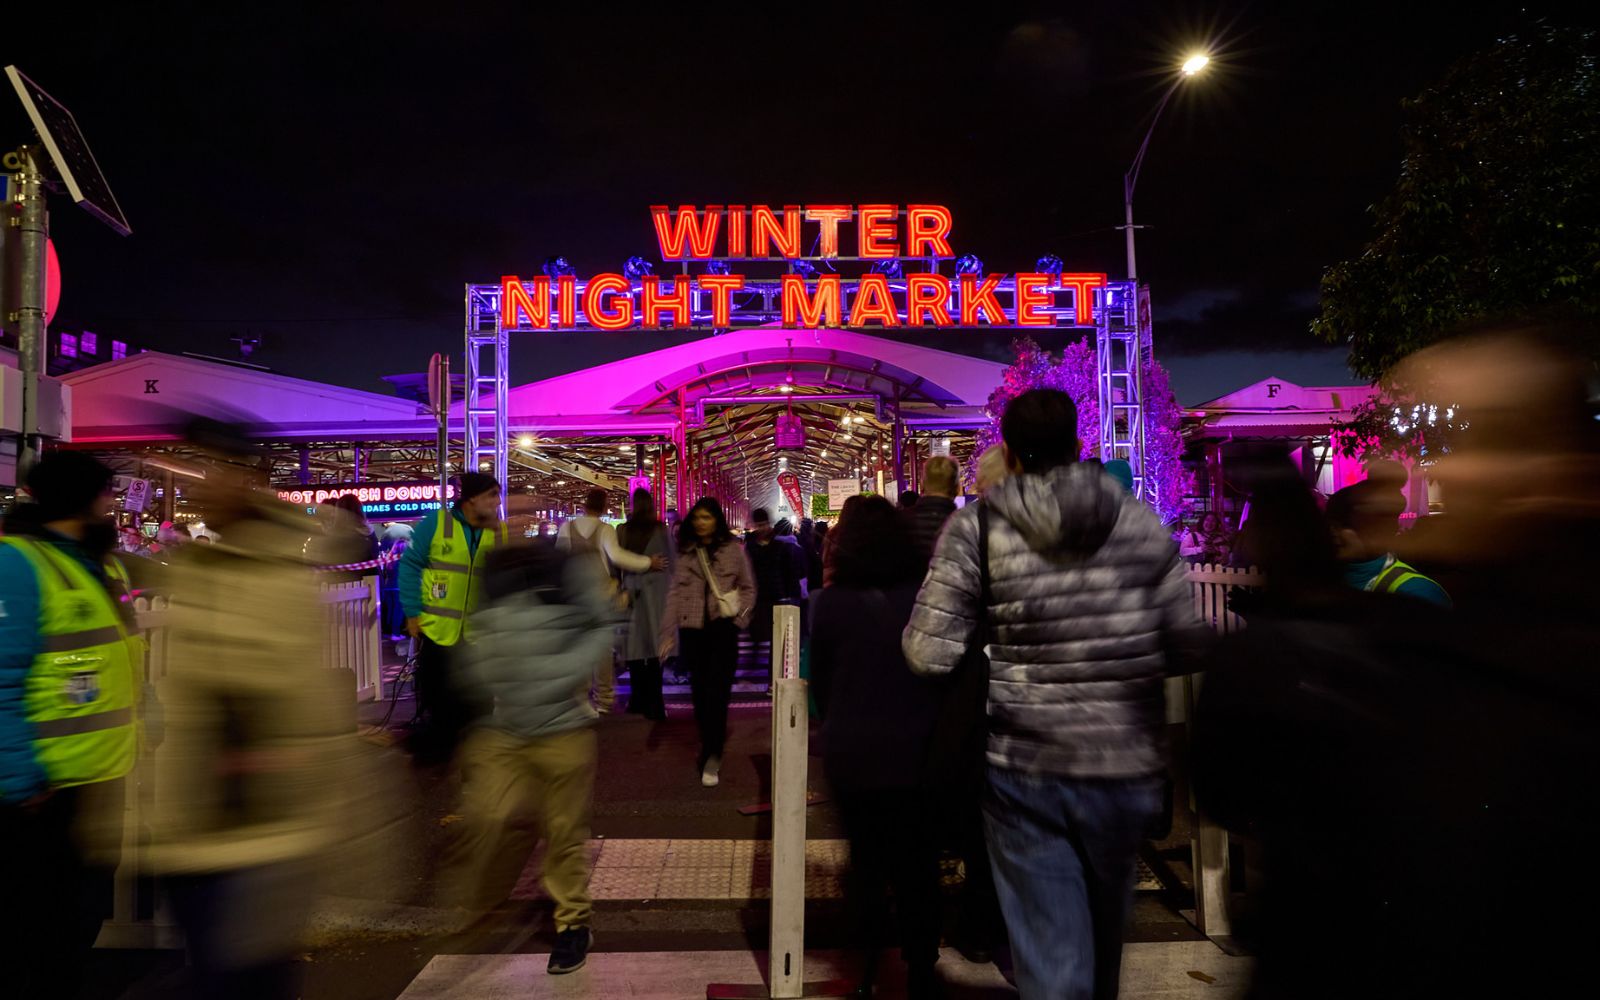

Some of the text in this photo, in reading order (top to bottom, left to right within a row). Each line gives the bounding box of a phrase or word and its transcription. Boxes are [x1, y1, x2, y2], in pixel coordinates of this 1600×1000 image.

[650, 205, 955, 258] WINTER
[501, 272, 1106, 330] NIGHT MARKET
[144, 380, 160, 393] K
[1267, 384, 1281, 398] F
[278, 490, 314, 503] HOT
[384, 485, 455, 500] DONUTS
[394, 503, 418, 511] COLD
